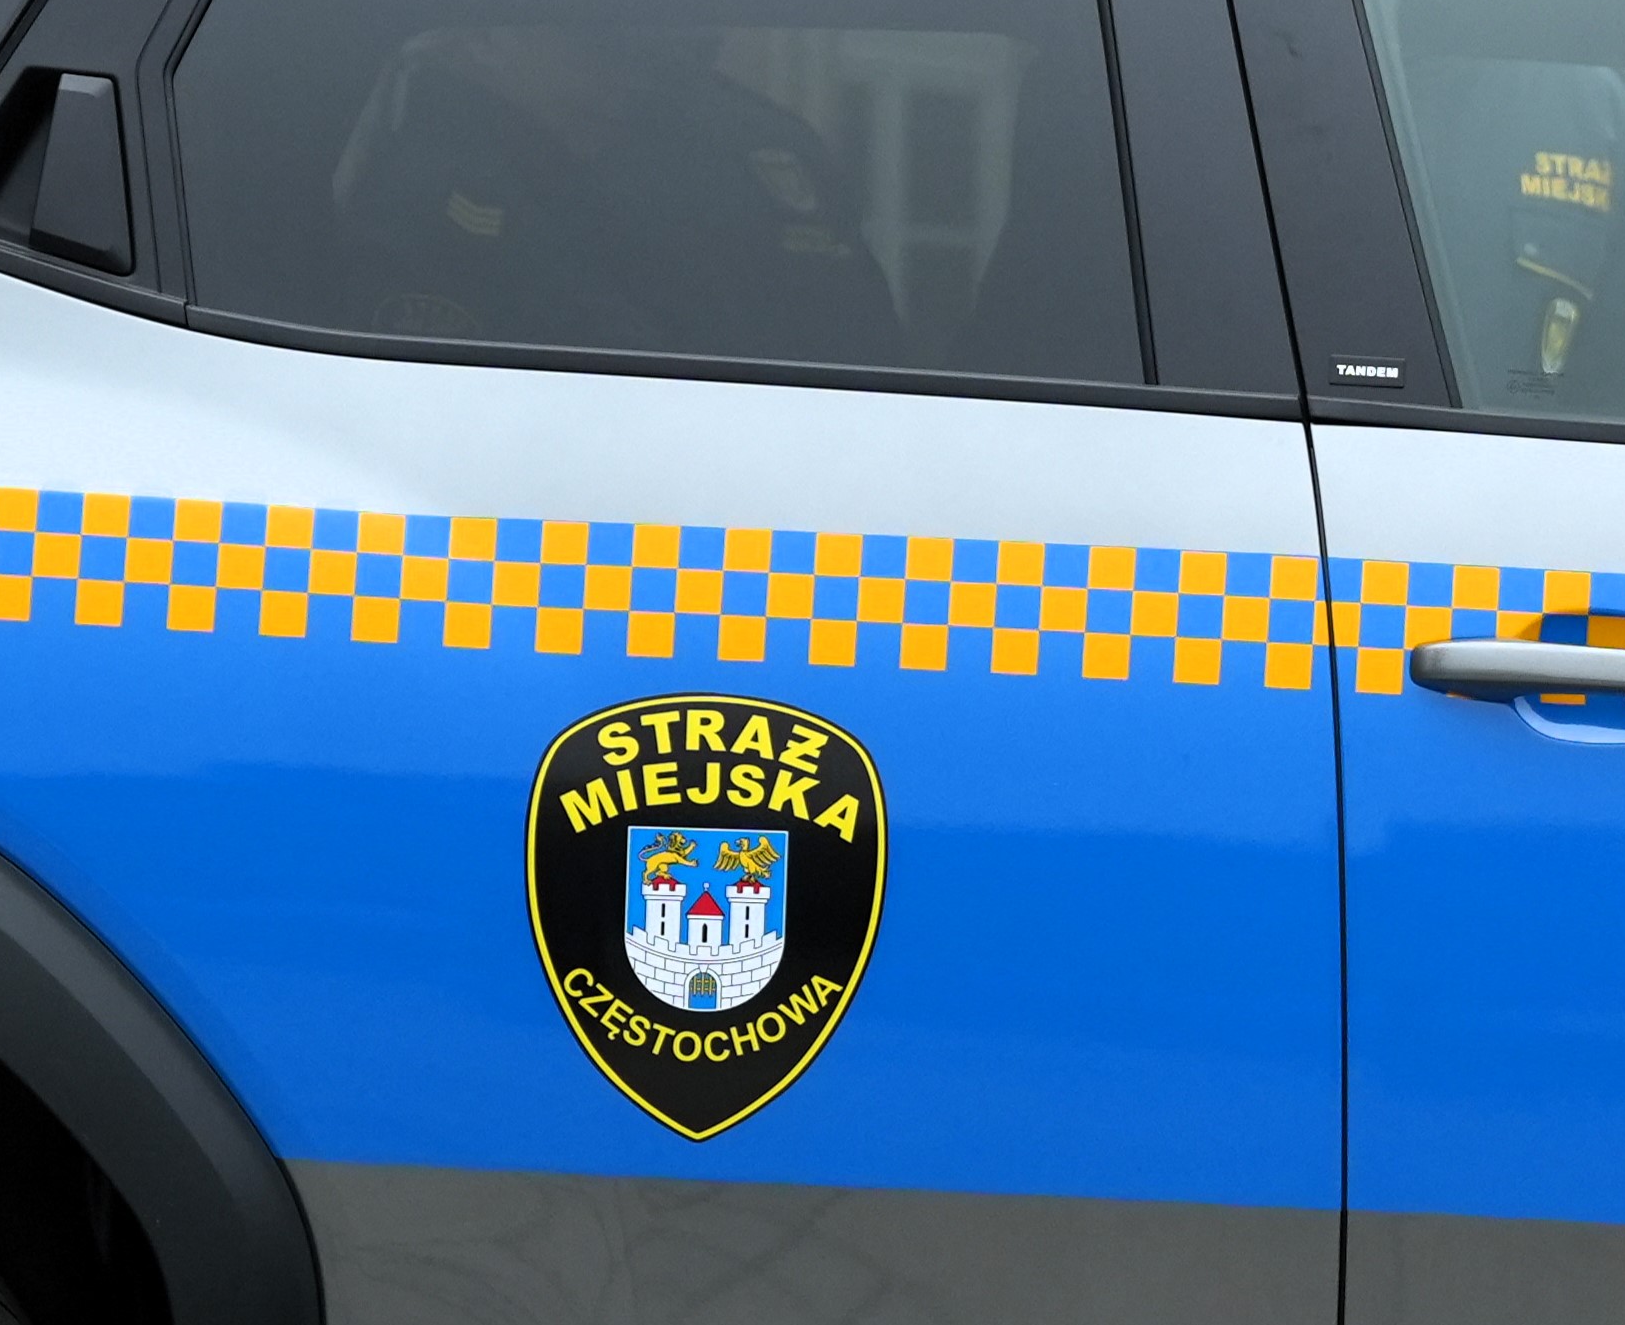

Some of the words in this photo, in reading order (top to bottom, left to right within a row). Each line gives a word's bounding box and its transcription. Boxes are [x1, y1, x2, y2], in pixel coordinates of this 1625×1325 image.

[1336, 363, 1399, 379] TANDEM
[559, 761, 860, 844] MIEJSKA
[563, 967, 843, 1061] CZĘSTOCHOWA
